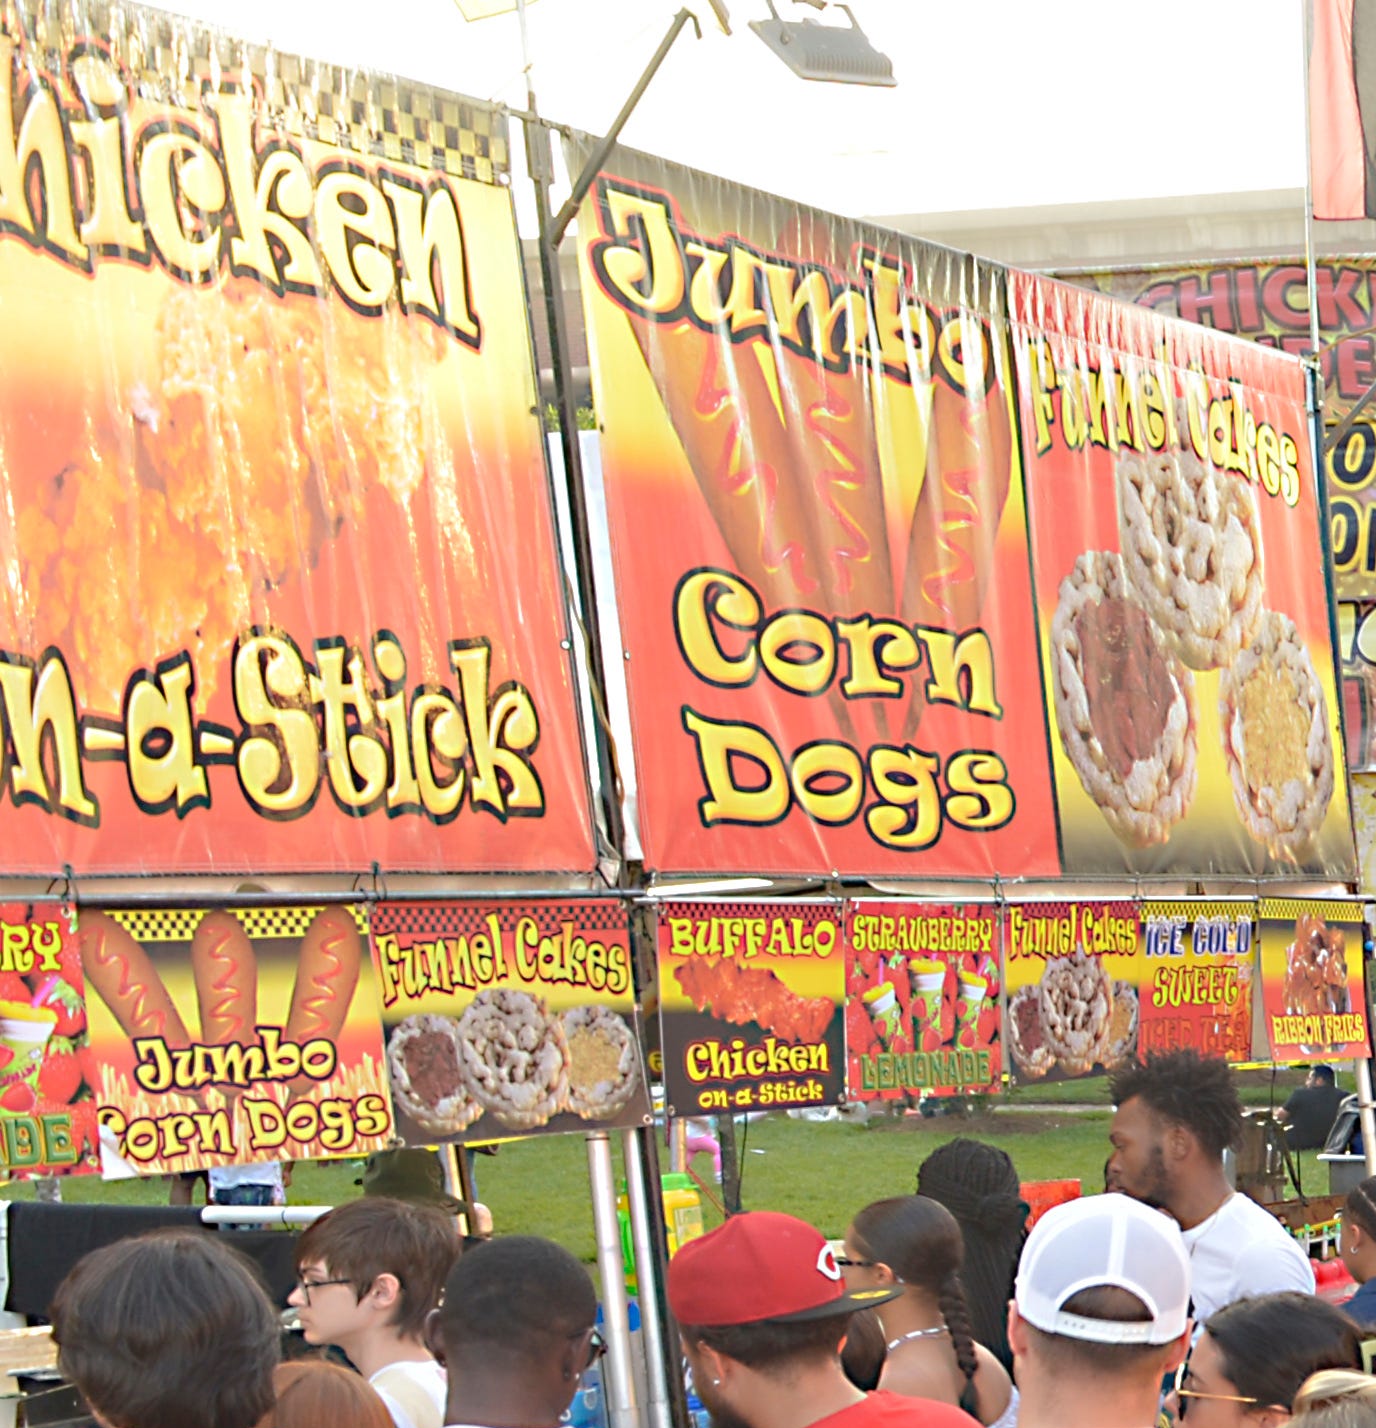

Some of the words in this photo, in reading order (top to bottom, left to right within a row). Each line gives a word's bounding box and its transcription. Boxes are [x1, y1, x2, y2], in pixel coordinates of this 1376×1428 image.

[592, 180, 996, 398] Jumbo
[1026, 340, 1178, 457] Funnel
[1188, 360, 1301, 509] Cakes
[672, 565, 1004, 721] Corn
[681, 704, 1016, 852] Dogs
[667, 915, 838, 959] BUFFALO
[850, 912, 994, 953] STRAWBERRY
[1008, 902, 1078, 961] Funnel
[1080, 903, 1139, 957] Cakes
[1145, 914, 1188, 957] ICE
[374, 913, 508, 1009] Funnel
[515, 914, 630, 994] Cakes
[1151, 963, 1239, 1009] SWEET
[1270, 1011, 1323, 1046] RIBBON
[1323, 1011, 1366, 1046] FRIES
[133, 1026, 337, 1094] Jumbo
[684, 1036, 831, 1085] Chicken
[859, 1050, 992, 1091] LEMONADE
[697, 1078, 825, 1109] on-a-Stick
[242, 1094, 392, 1151] Dogs
